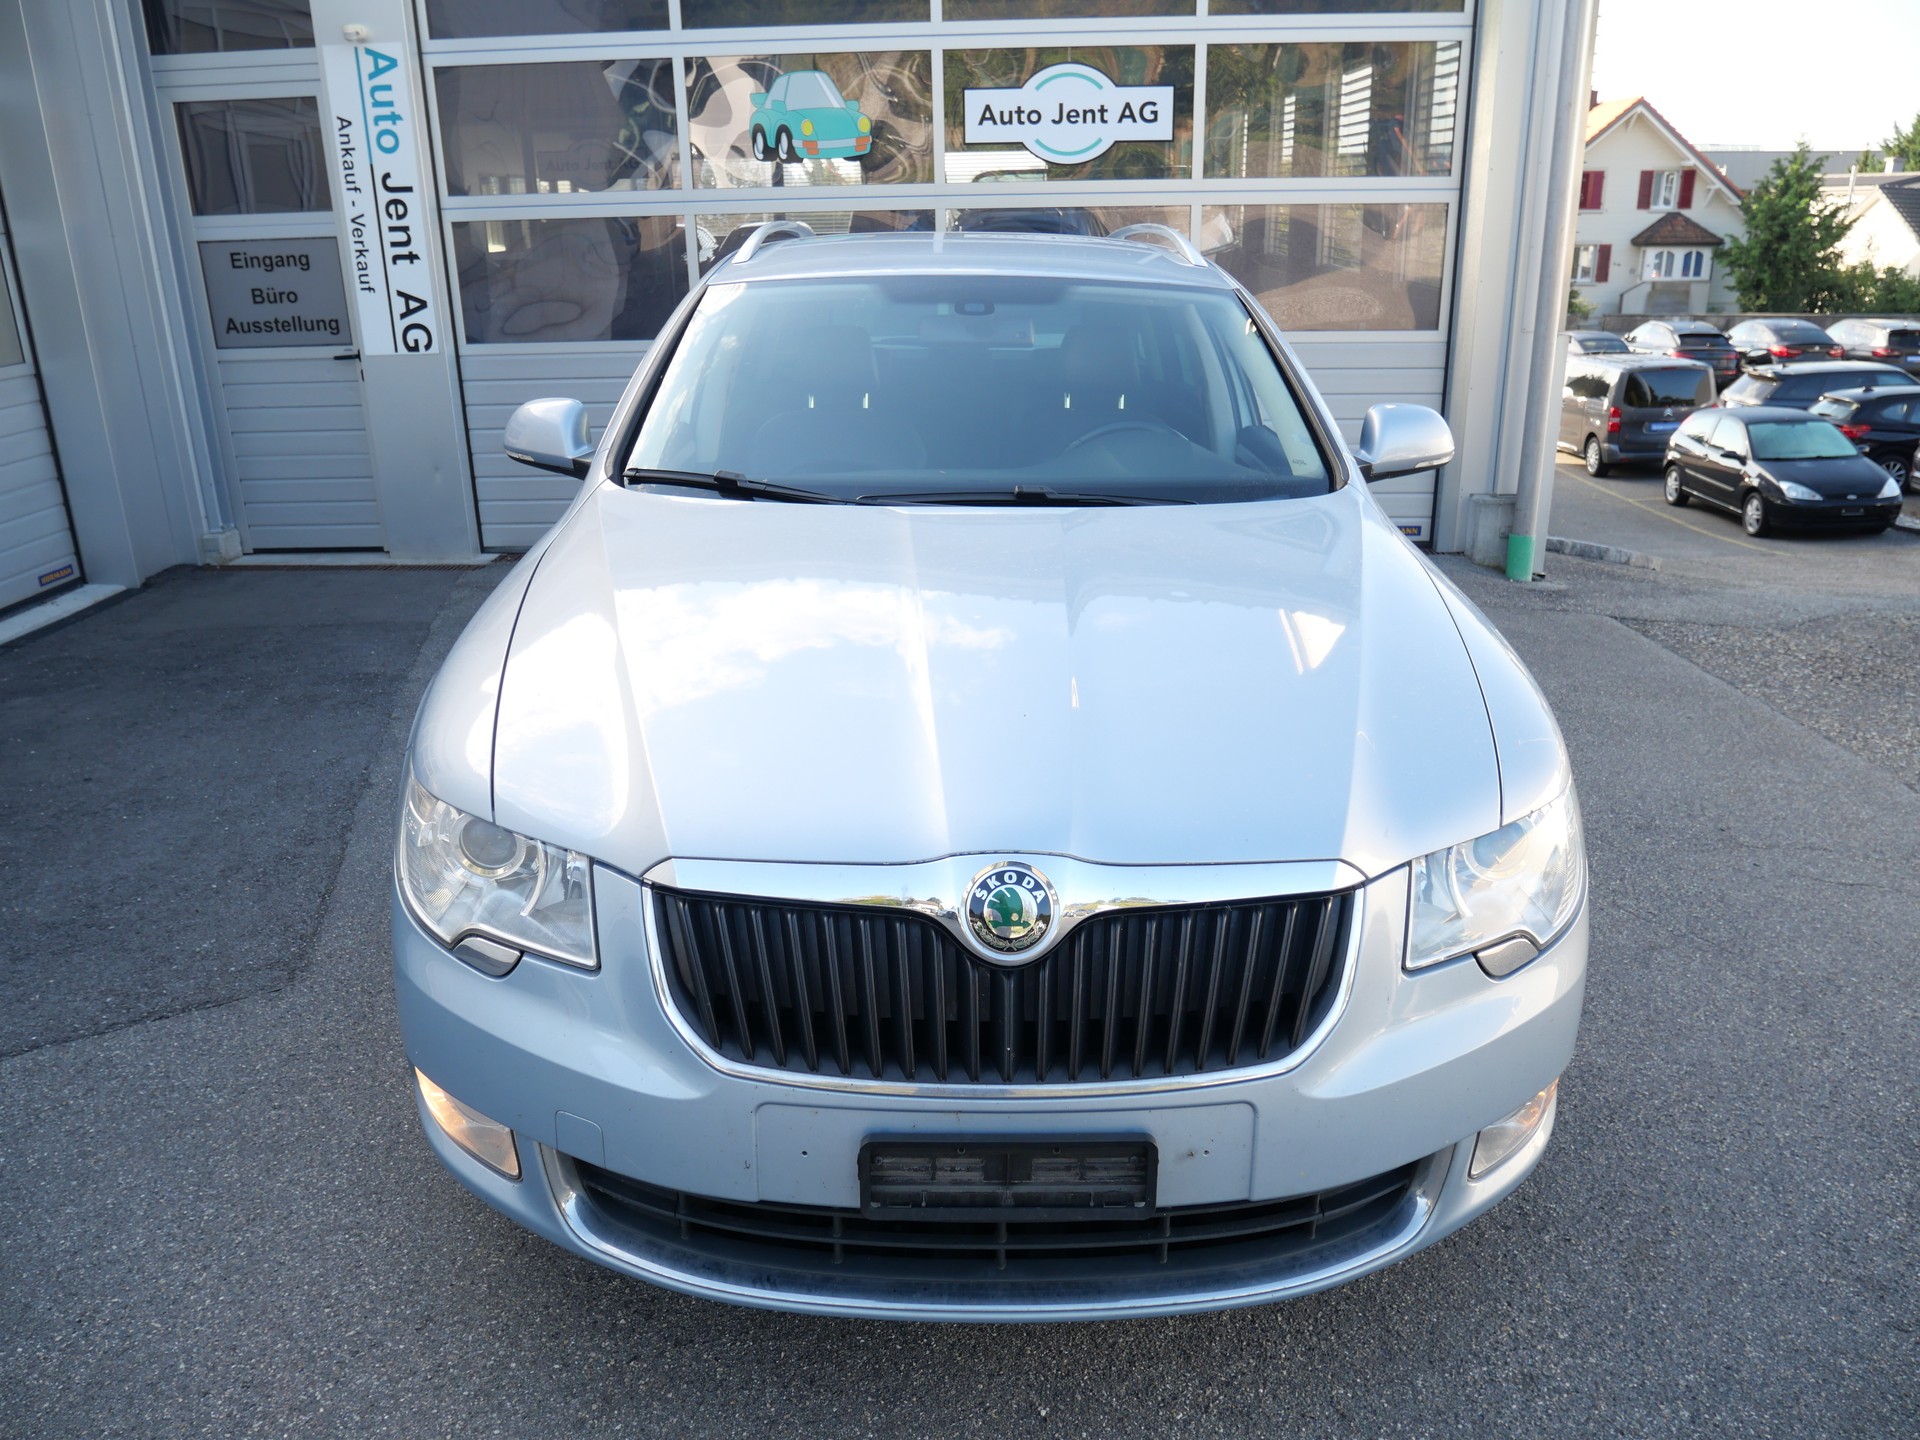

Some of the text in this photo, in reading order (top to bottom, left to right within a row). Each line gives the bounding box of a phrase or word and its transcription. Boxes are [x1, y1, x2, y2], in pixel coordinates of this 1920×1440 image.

[978, 101, 1159, 126] Auto Jent AG
[336, 115, 362, 193] Ankauf
[350, 214, 376, 294] Verkauf
[364, 47, 433, 354] Auto Jent AG
[229, 251, 311, 272] Eingang
[250, 287, 299, 306] Büro
[225, 315, 341, 336] Ausstellung
